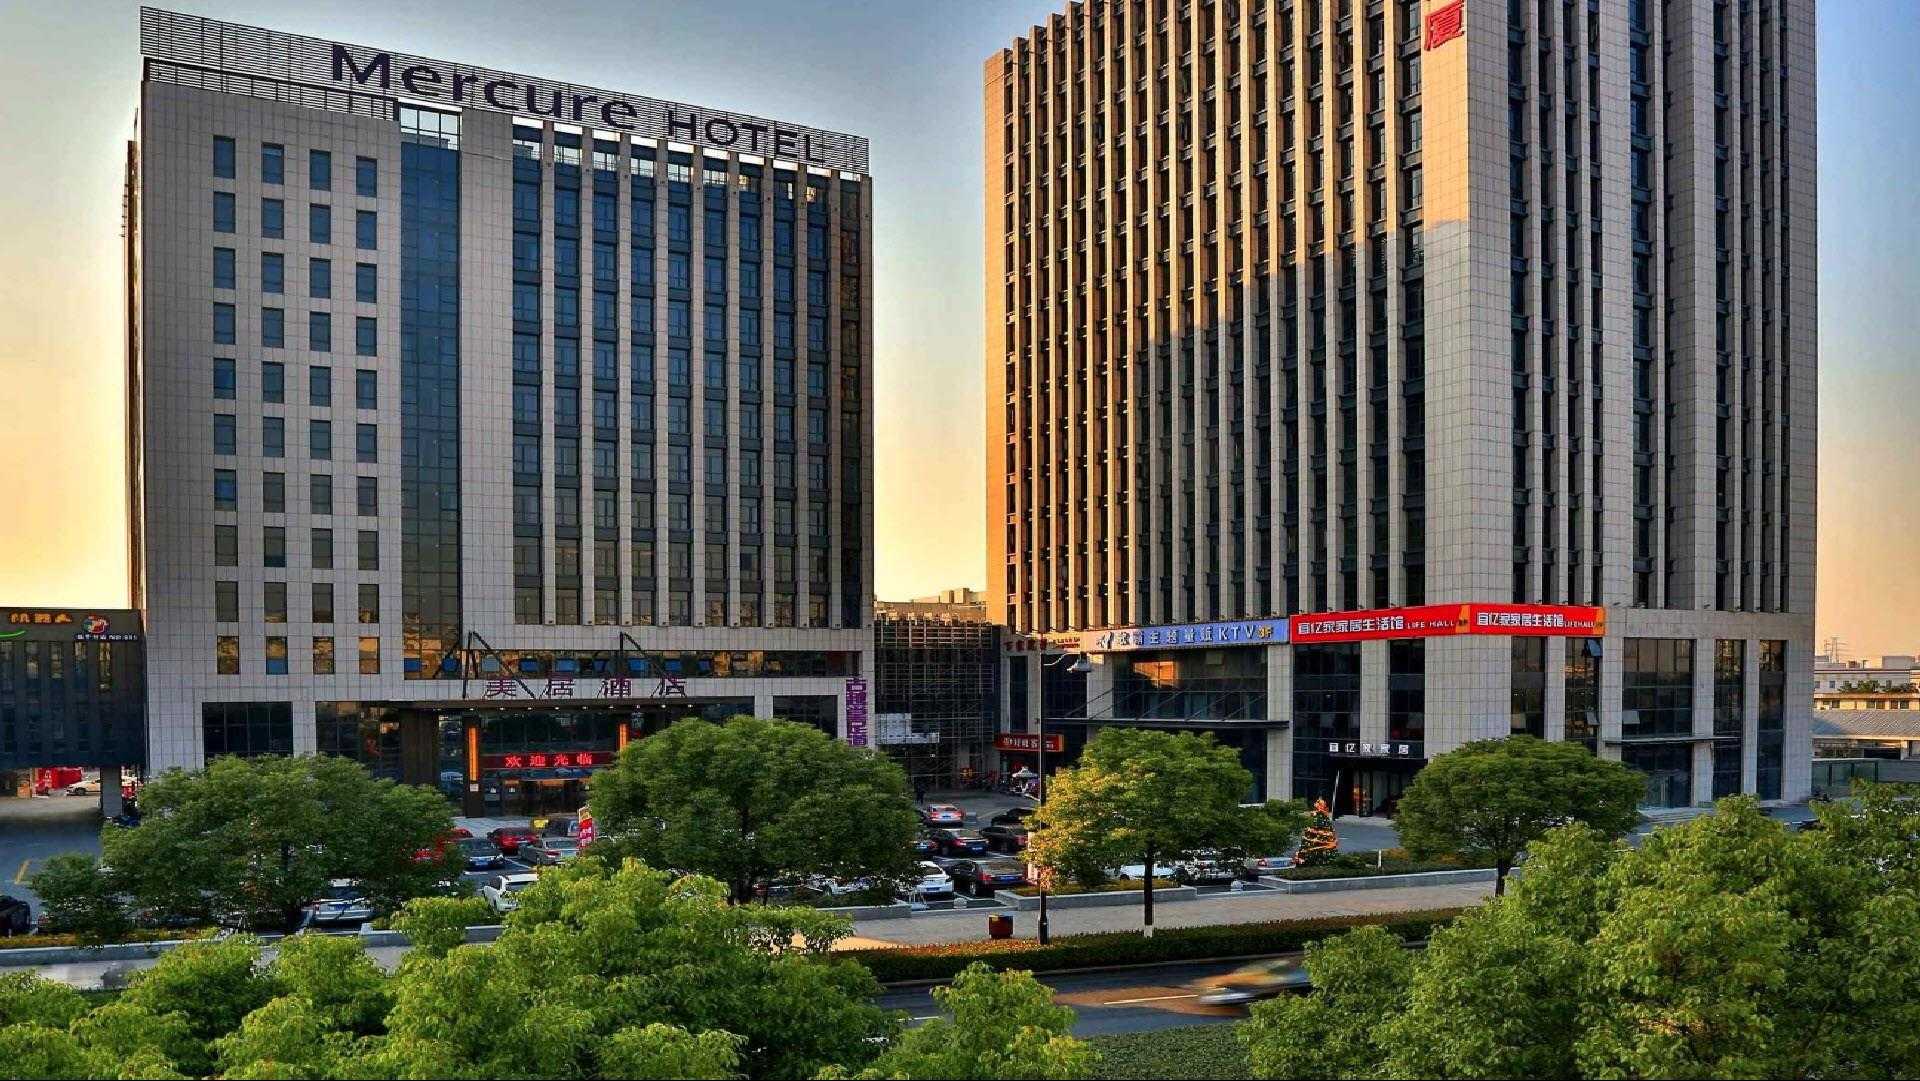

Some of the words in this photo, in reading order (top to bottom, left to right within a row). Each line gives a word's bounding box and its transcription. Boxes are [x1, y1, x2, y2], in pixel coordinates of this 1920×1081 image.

[333, 44, 638, 130] Mercure
[667, 110, 825, 163] HOTEL
[486, 672, 687, 697] 美居酒店
[505, 752, 593, 768] 欢迎光临
